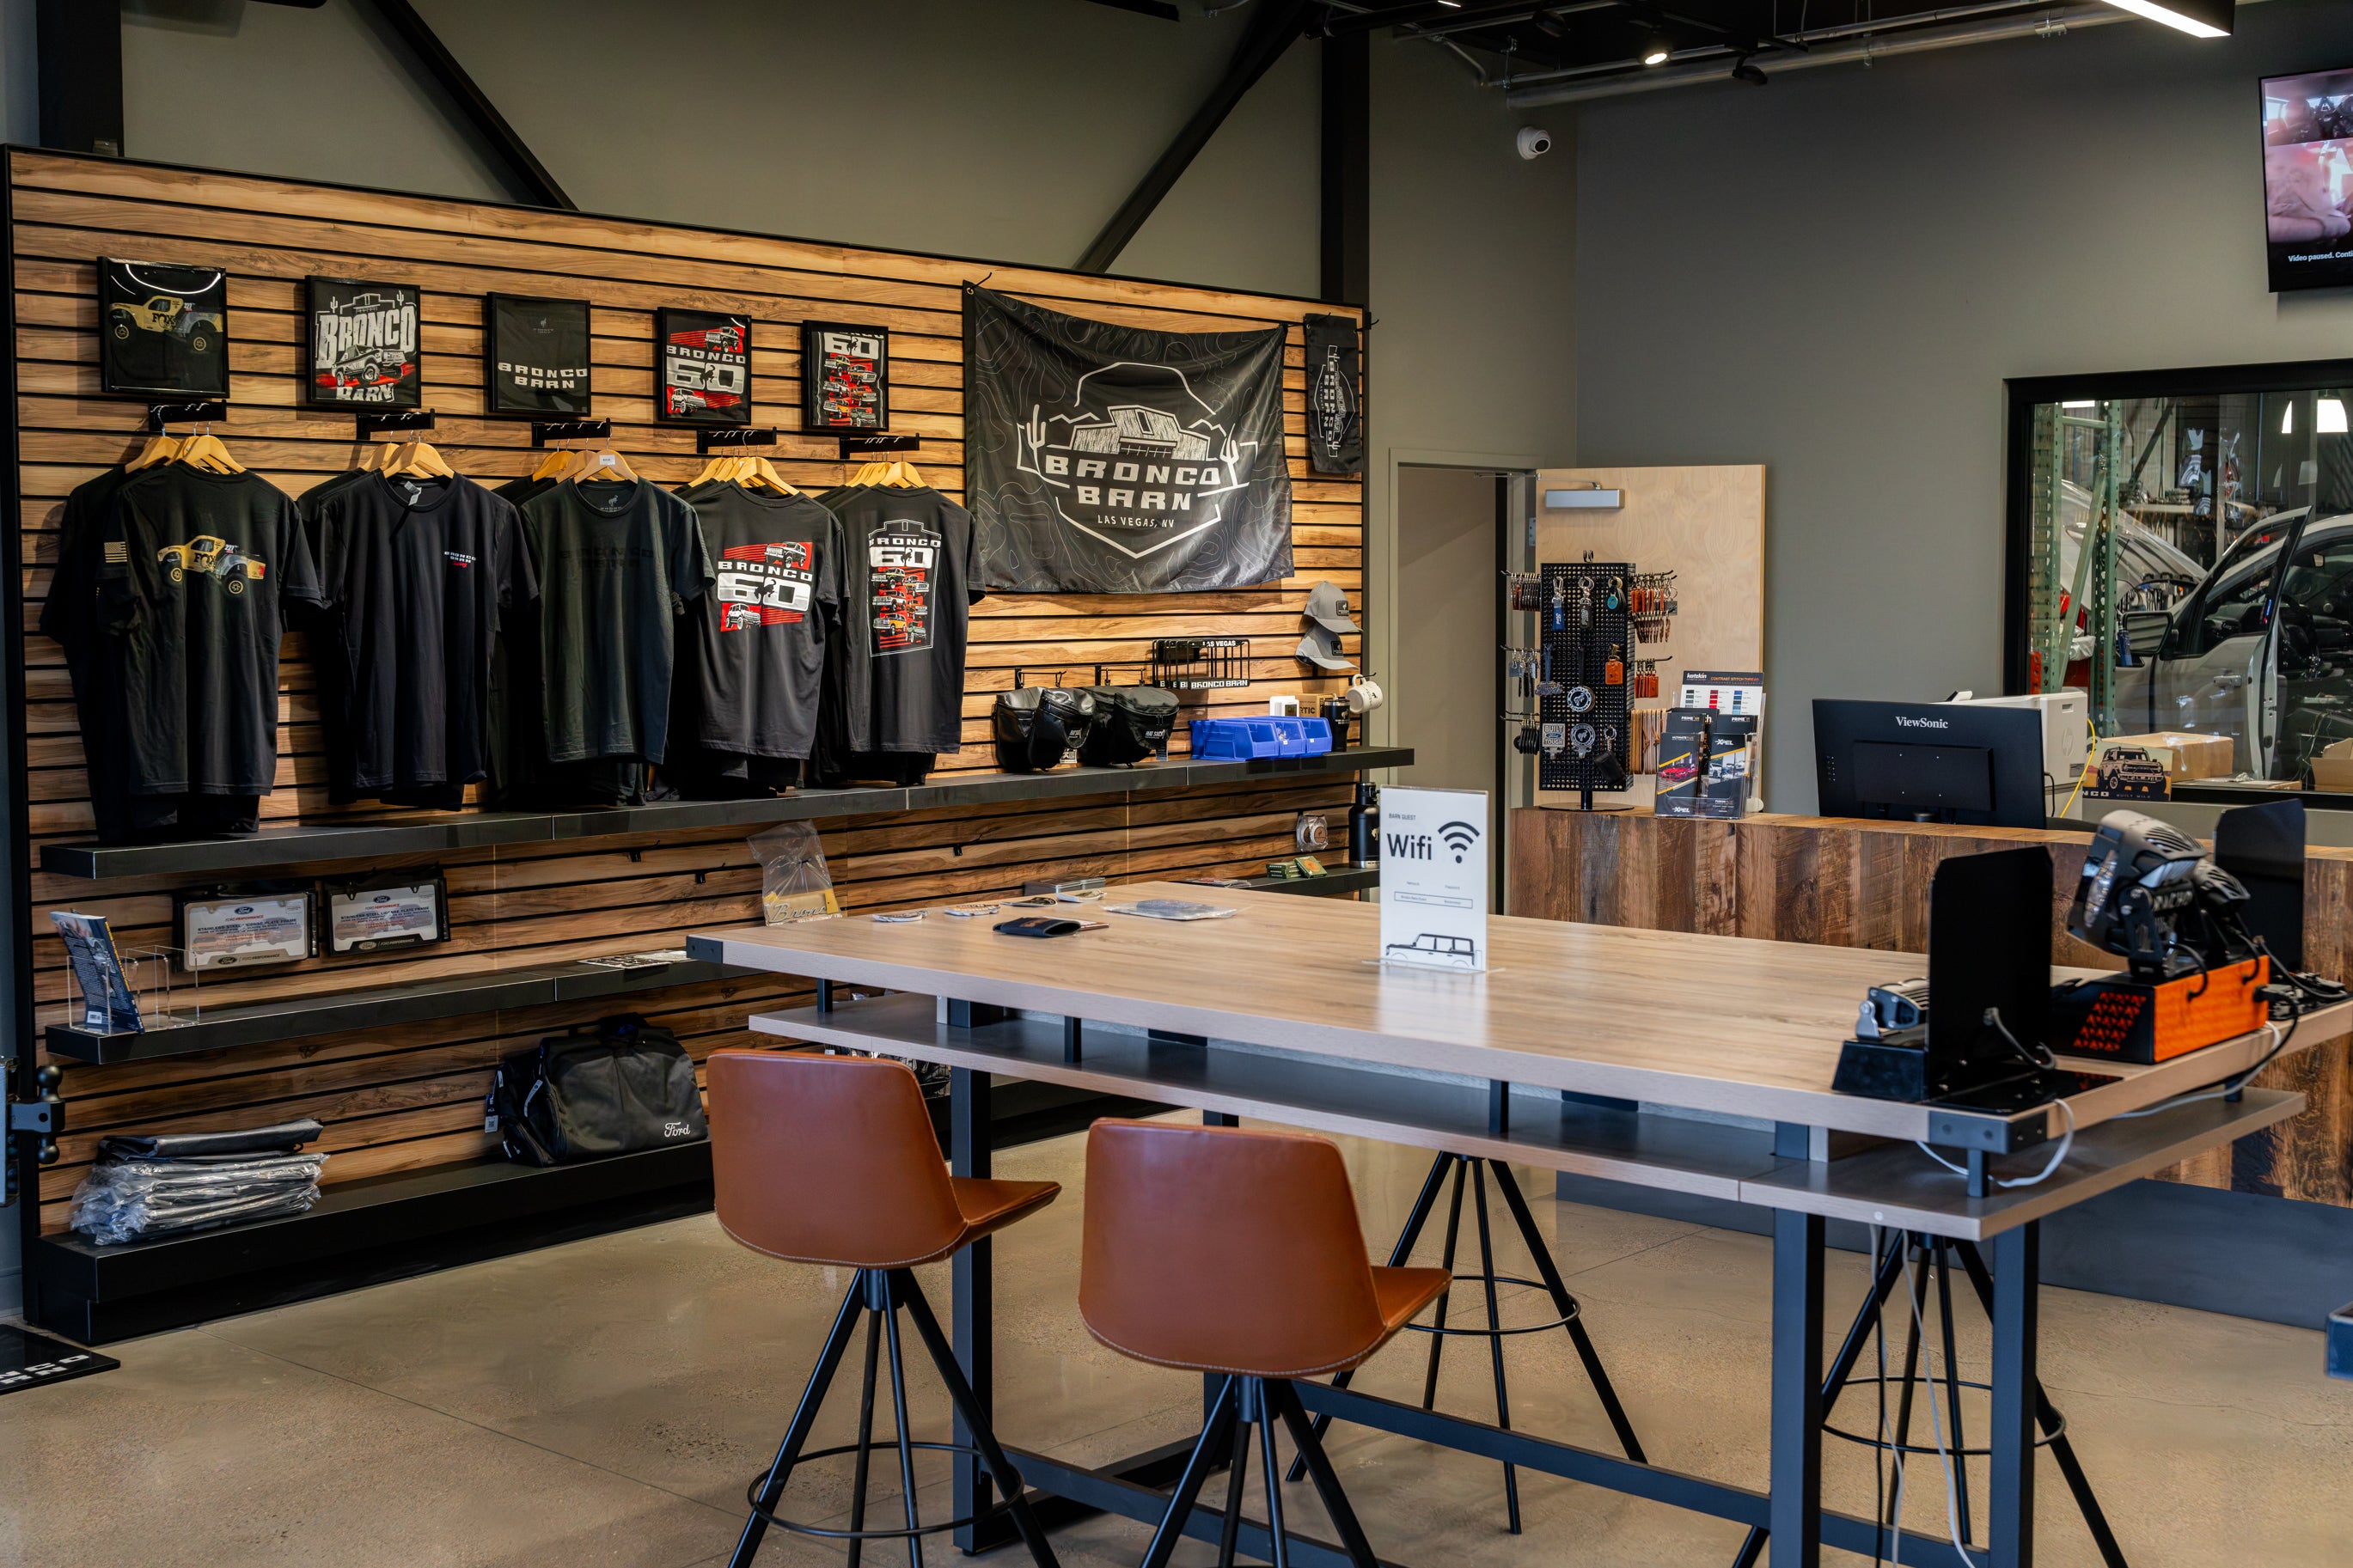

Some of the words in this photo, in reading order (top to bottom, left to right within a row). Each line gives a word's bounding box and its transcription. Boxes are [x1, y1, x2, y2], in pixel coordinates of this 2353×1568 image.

[2288, 253, 2307, 262] Video
[2308, 252, 2335, 262] paused.
[152, 312, 176, 326] FOX
[315, 305, 416, 369] BRONCO
[823, 332, 879, 360] 60
[666, 345, 746, 363] BRONCO
[498, 362, 588, 378] BRONCO
[666, 356, 745, 394] 60
[514, 375, 575, 389] BARN
[336, 382, 394, 401] BARN
[1045, 455, 1221, 485] BRONCO
[1077, 485, 1191, 510] BARN
[1097, 515, 1116, 525] LAS
[1121, 516, 1158, 528] VEGAS,
[1161, 519, 1175, 528] NV
[869, 537, 941, 548] BRONCO
[193, 552, 217, 569] FOX
[443, 551, 476, 561] BRONCO
[870, 546, 933, 569] 60
[718, 561, 813, 582] BRONCO
[717, 572, 811, 612] 60
[1191, 680, 1225, 689] BRONCO
[1895, 716, 1949, 729] ViewSonic
[1386, 833, 1432, 860] Wifi
[770, 903, 827, 923] Bronc
[663, 1122, 691, 1138] Ford
